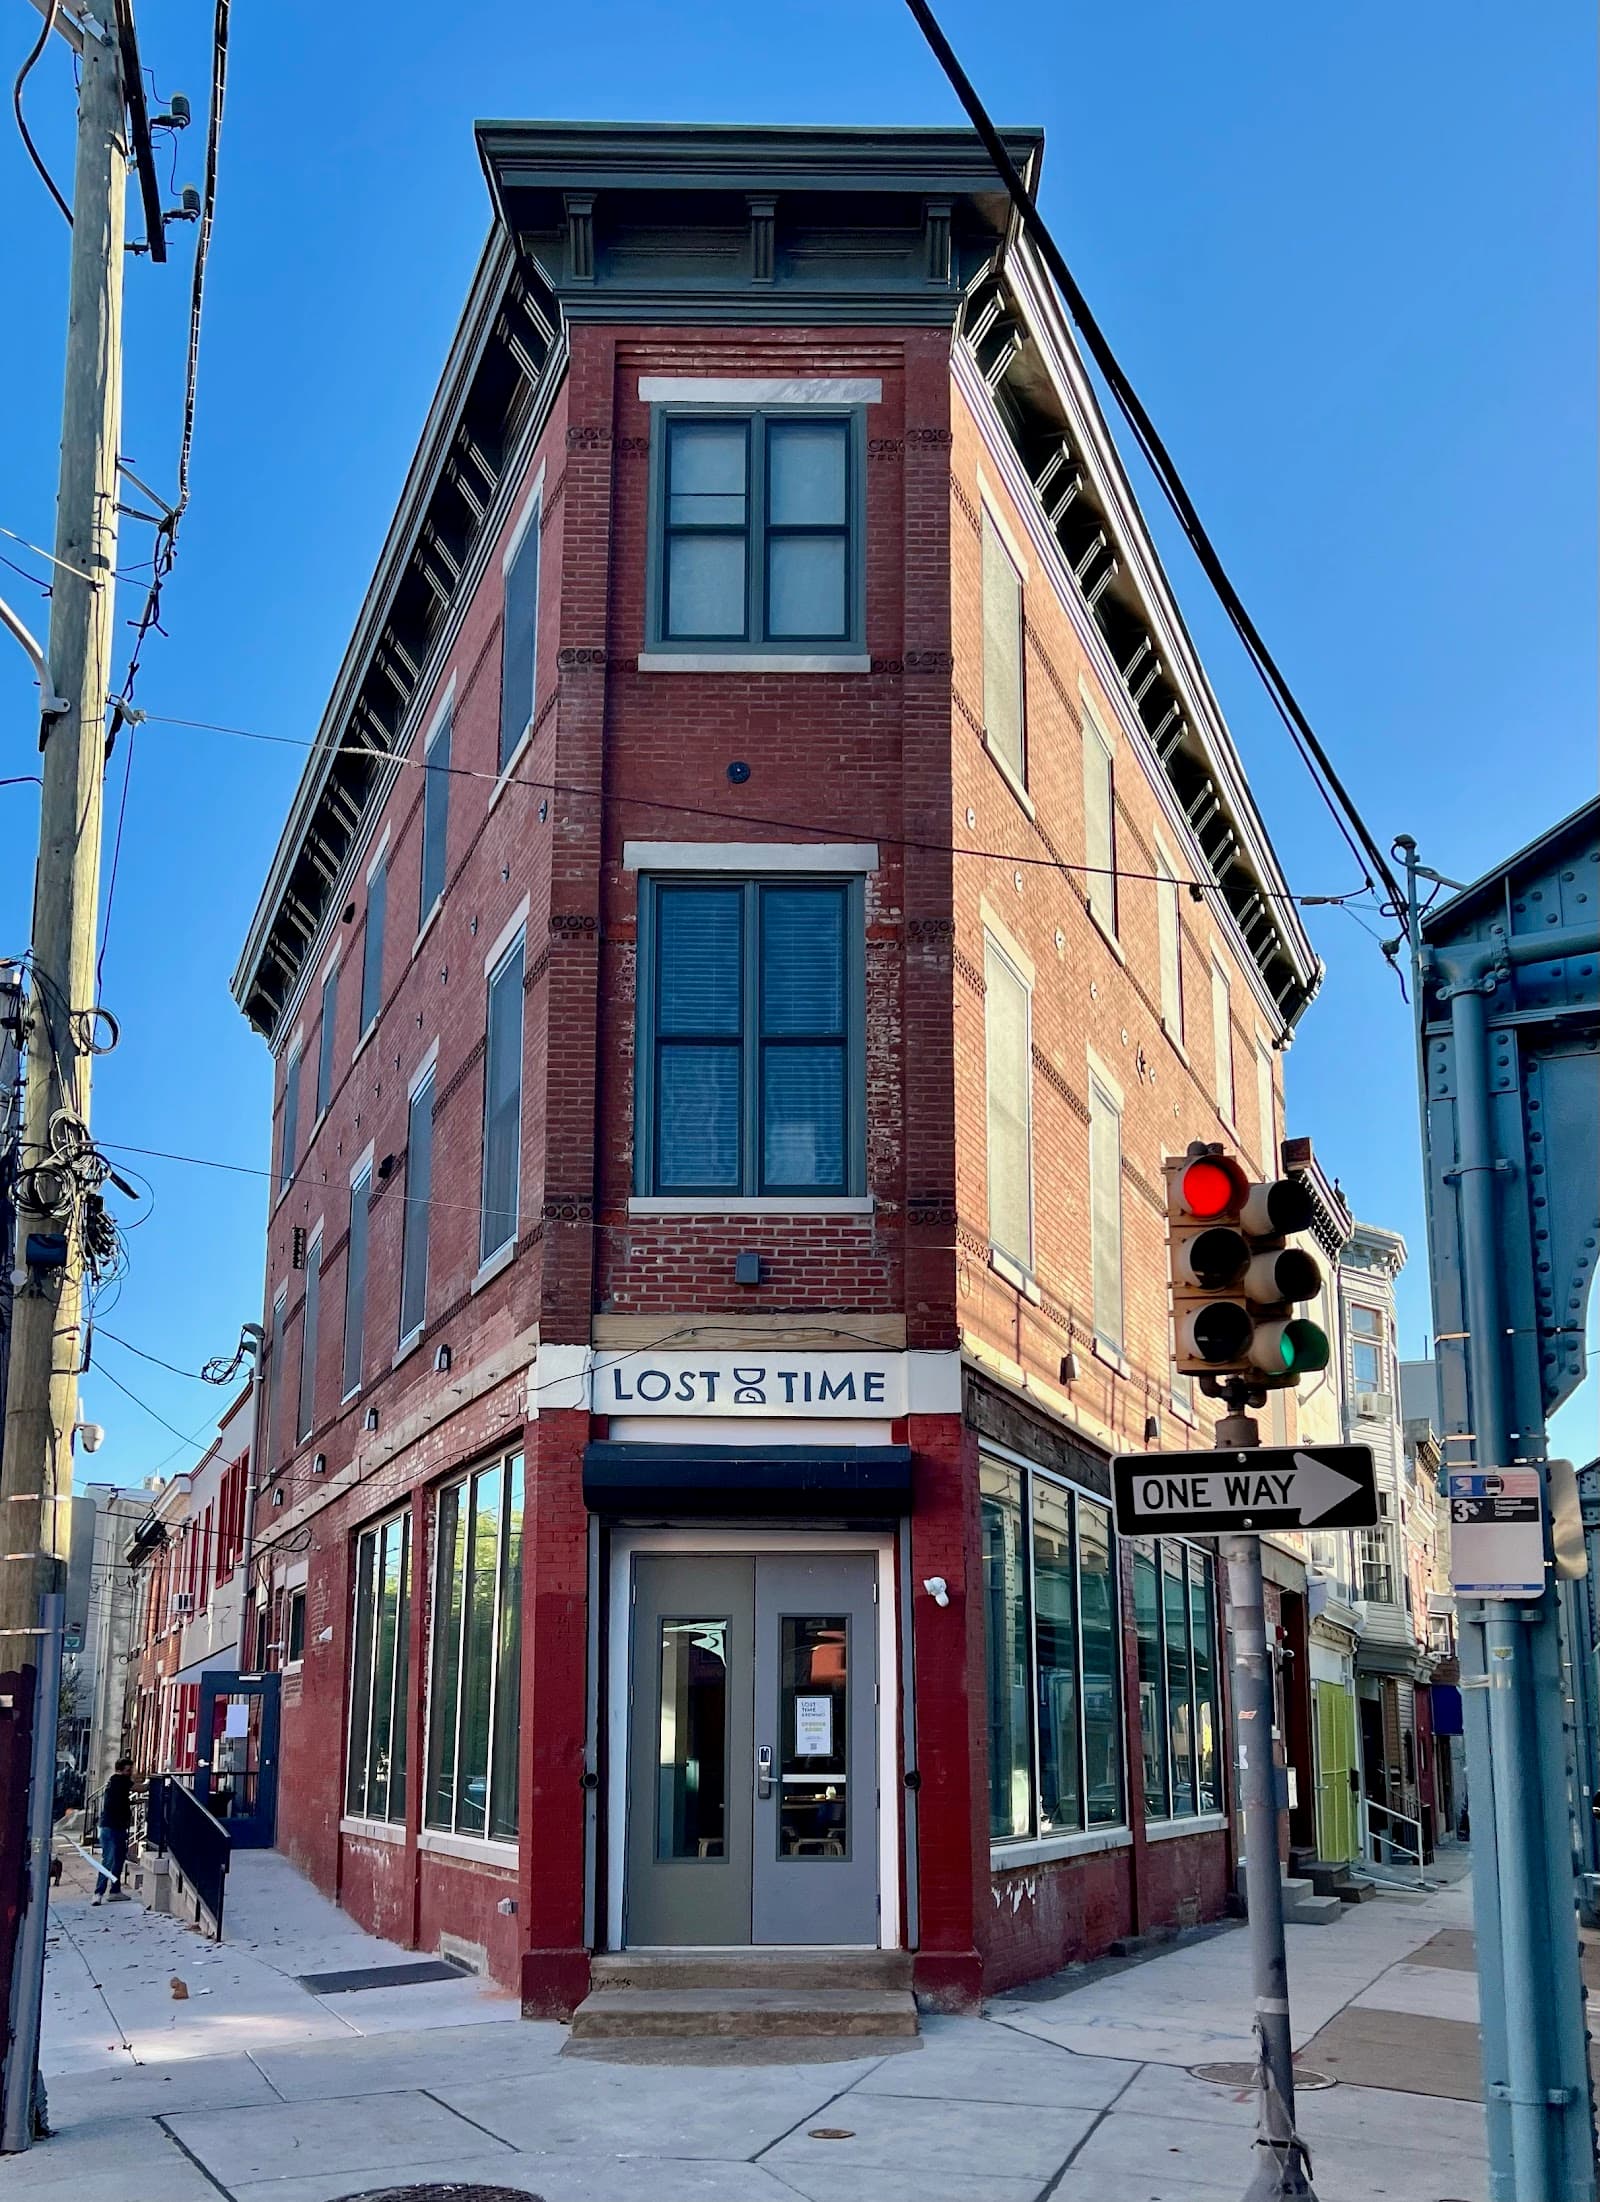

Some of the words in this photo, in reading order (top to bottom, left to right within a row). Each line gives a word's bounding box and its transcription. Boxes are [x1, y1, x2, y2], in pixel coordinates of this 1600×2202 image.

[613, 1368, 720, 1403] LOST
[777, 1370, 885, 1403] TIME
[1142, 1477, 1212, 1510] ONE
[1223, 1474, 1296, 1507] WAY
[1453, 1499, 1470, 1523] 3
